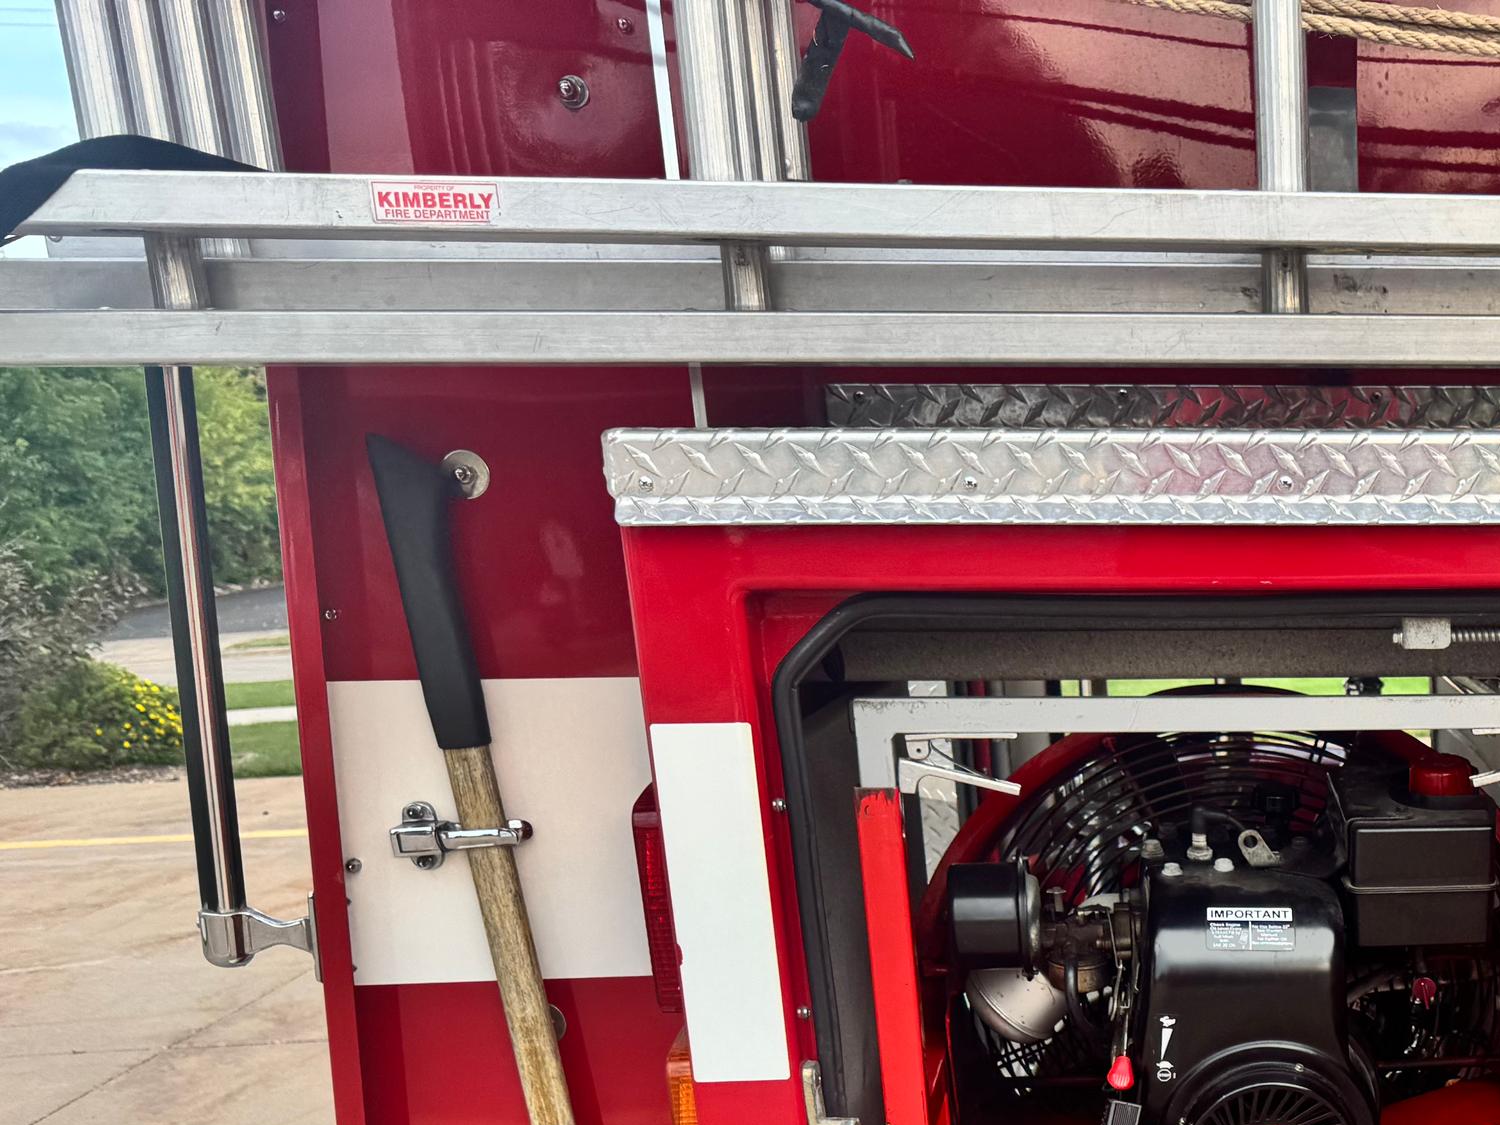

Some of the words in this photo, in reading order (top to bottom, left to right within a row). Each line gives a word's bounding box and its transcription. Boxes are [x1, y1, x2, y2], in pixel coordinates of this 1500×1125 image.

[378, 191, 493, 209] KIMBERLY
[384, 208, 411, 218] FIRE
[414, 209, 490, 220] DEPARTMENT
[1210, 909, 1289, 919] IMPORTANT
